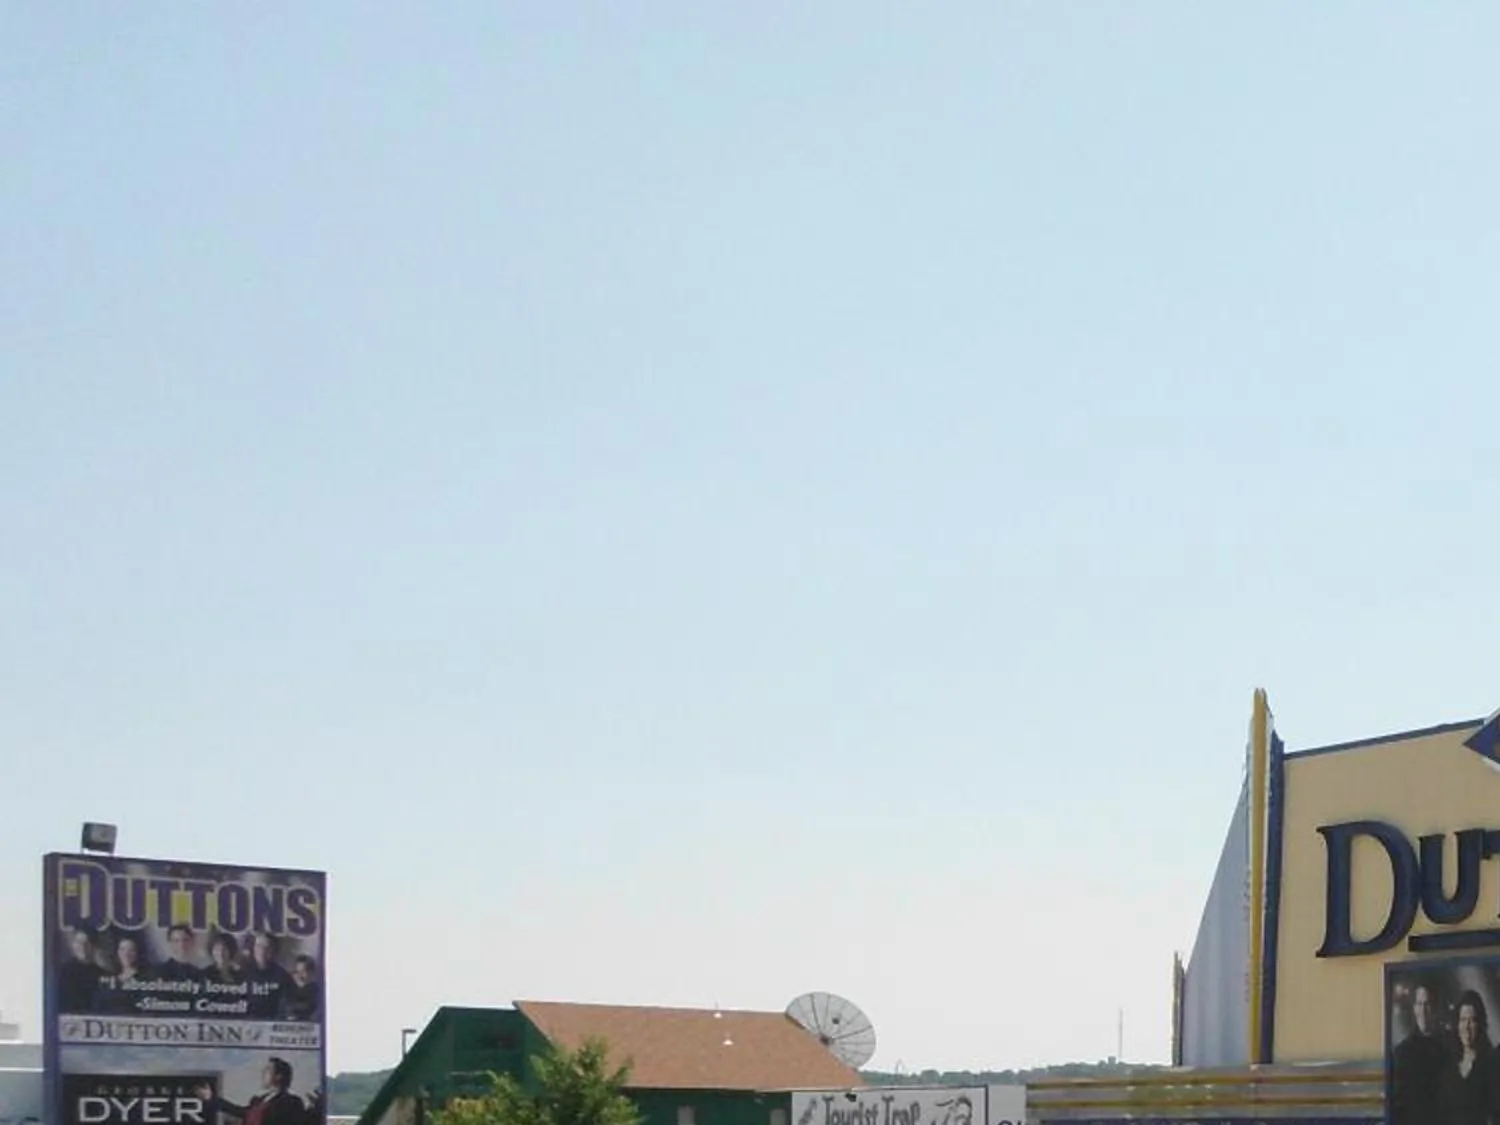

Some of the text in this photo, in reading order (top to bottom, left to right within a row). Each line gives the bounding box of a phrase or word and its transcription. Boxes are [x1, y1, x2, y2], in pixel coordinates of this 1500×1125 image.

[58, 859, 320, 938] DUTTONS
[122, 977, 200, 995] absolutely
[206, 980, 247, 995] loved
[196, 999, 248, 1013] Cowell
[83, 1019, 243, 1043] DUTTON INN
[79, 1097, 206, 1122] DYER
